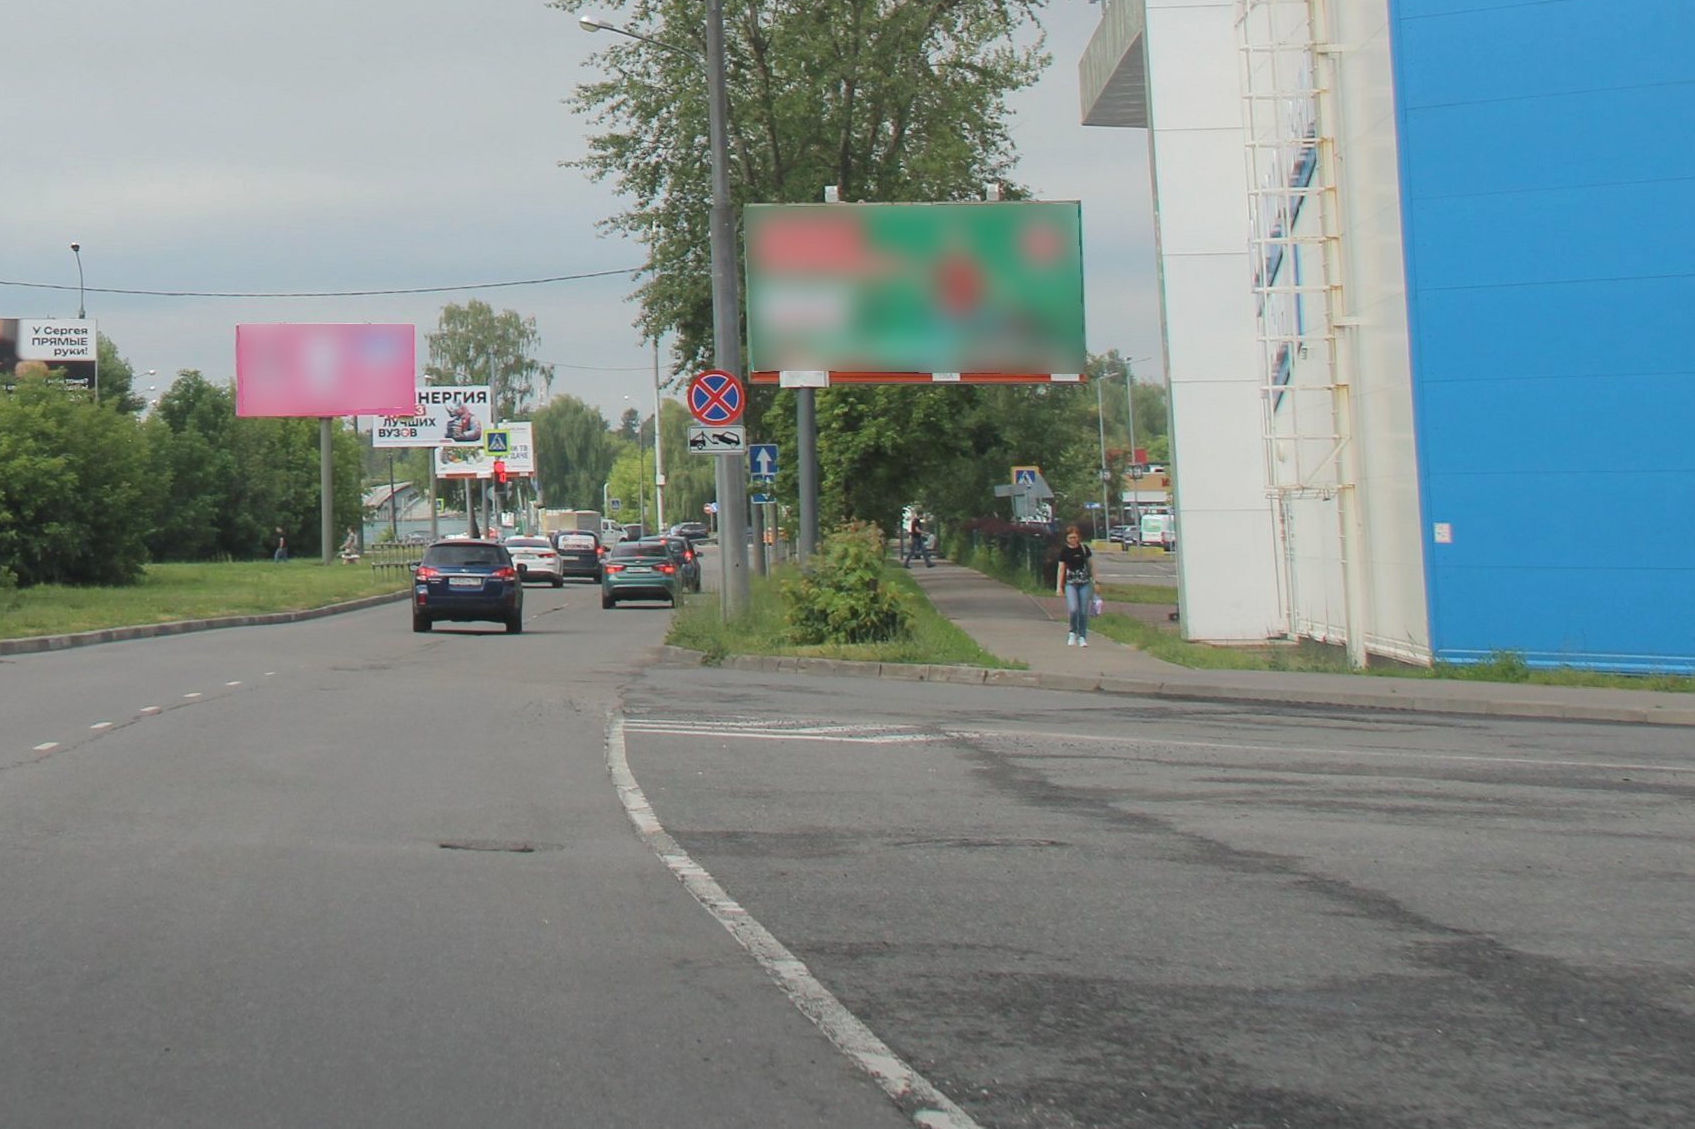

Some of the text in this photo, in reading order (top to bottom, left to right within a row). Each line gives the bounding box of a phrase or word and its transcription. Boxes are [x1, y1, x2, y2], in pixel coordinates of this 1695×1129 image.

[33, 326, 88, 336] У Сергея
[32, 337, 88, 346] ПРЯМЫЕ
[54, 347, 88, 357] руки!
[418, 391, 487, 404] НЕРГИЯ
[383, 418, 436, 427] ЛУЧШИХ
[378, 429, 417, 437] ВУЗОВ
